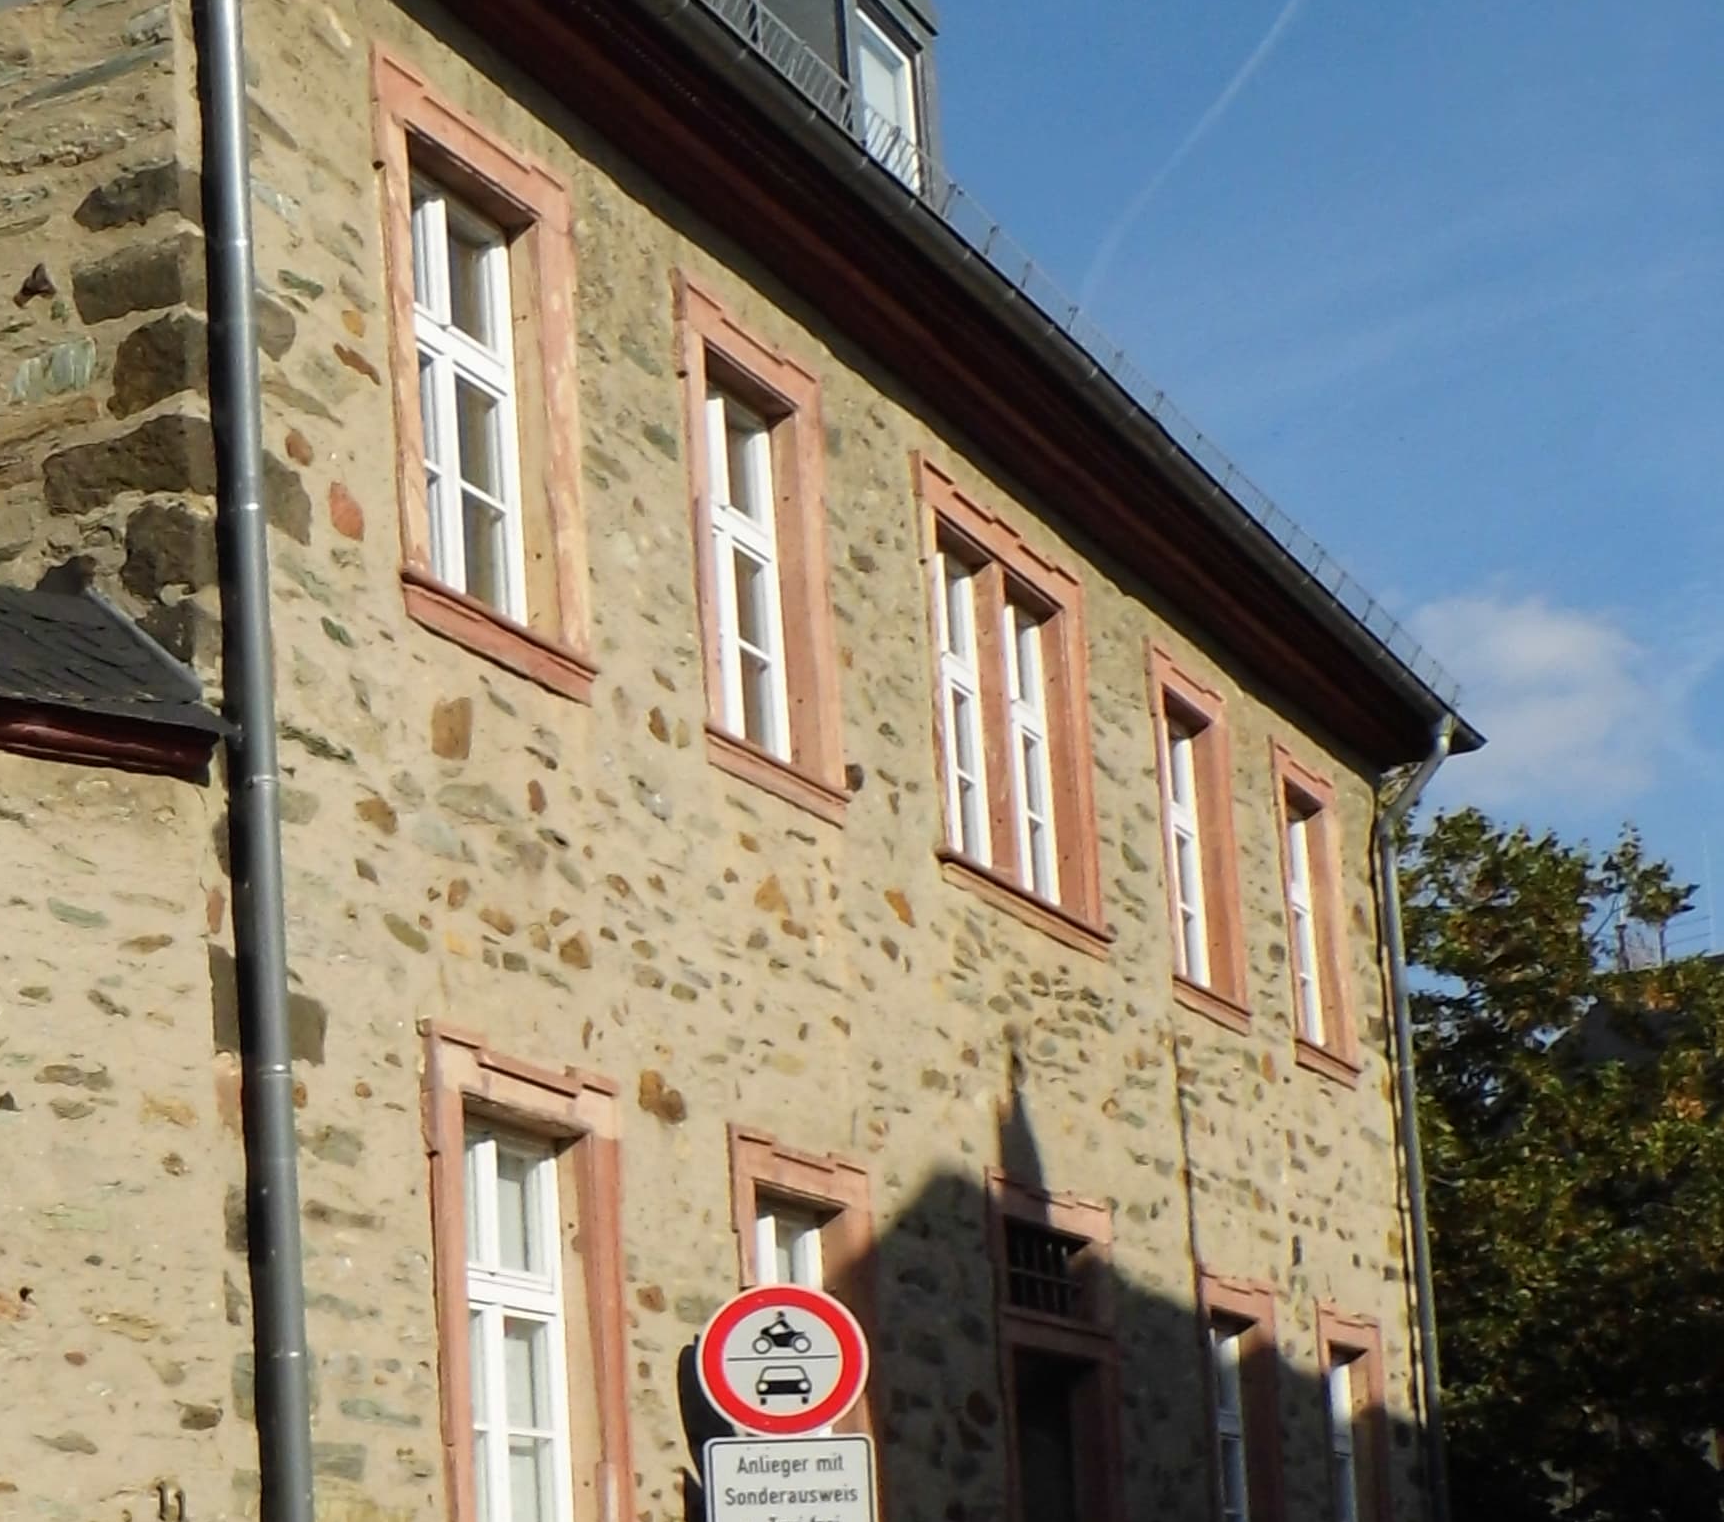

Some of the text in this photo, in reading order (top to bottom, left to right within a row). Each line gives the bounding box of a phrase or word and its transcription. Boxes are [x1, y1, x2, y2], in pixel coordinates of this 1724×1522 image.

[737, 1453, 844, 1478] Anlieger mit
[725, 1485, 859, 1506] Sonderausweis
